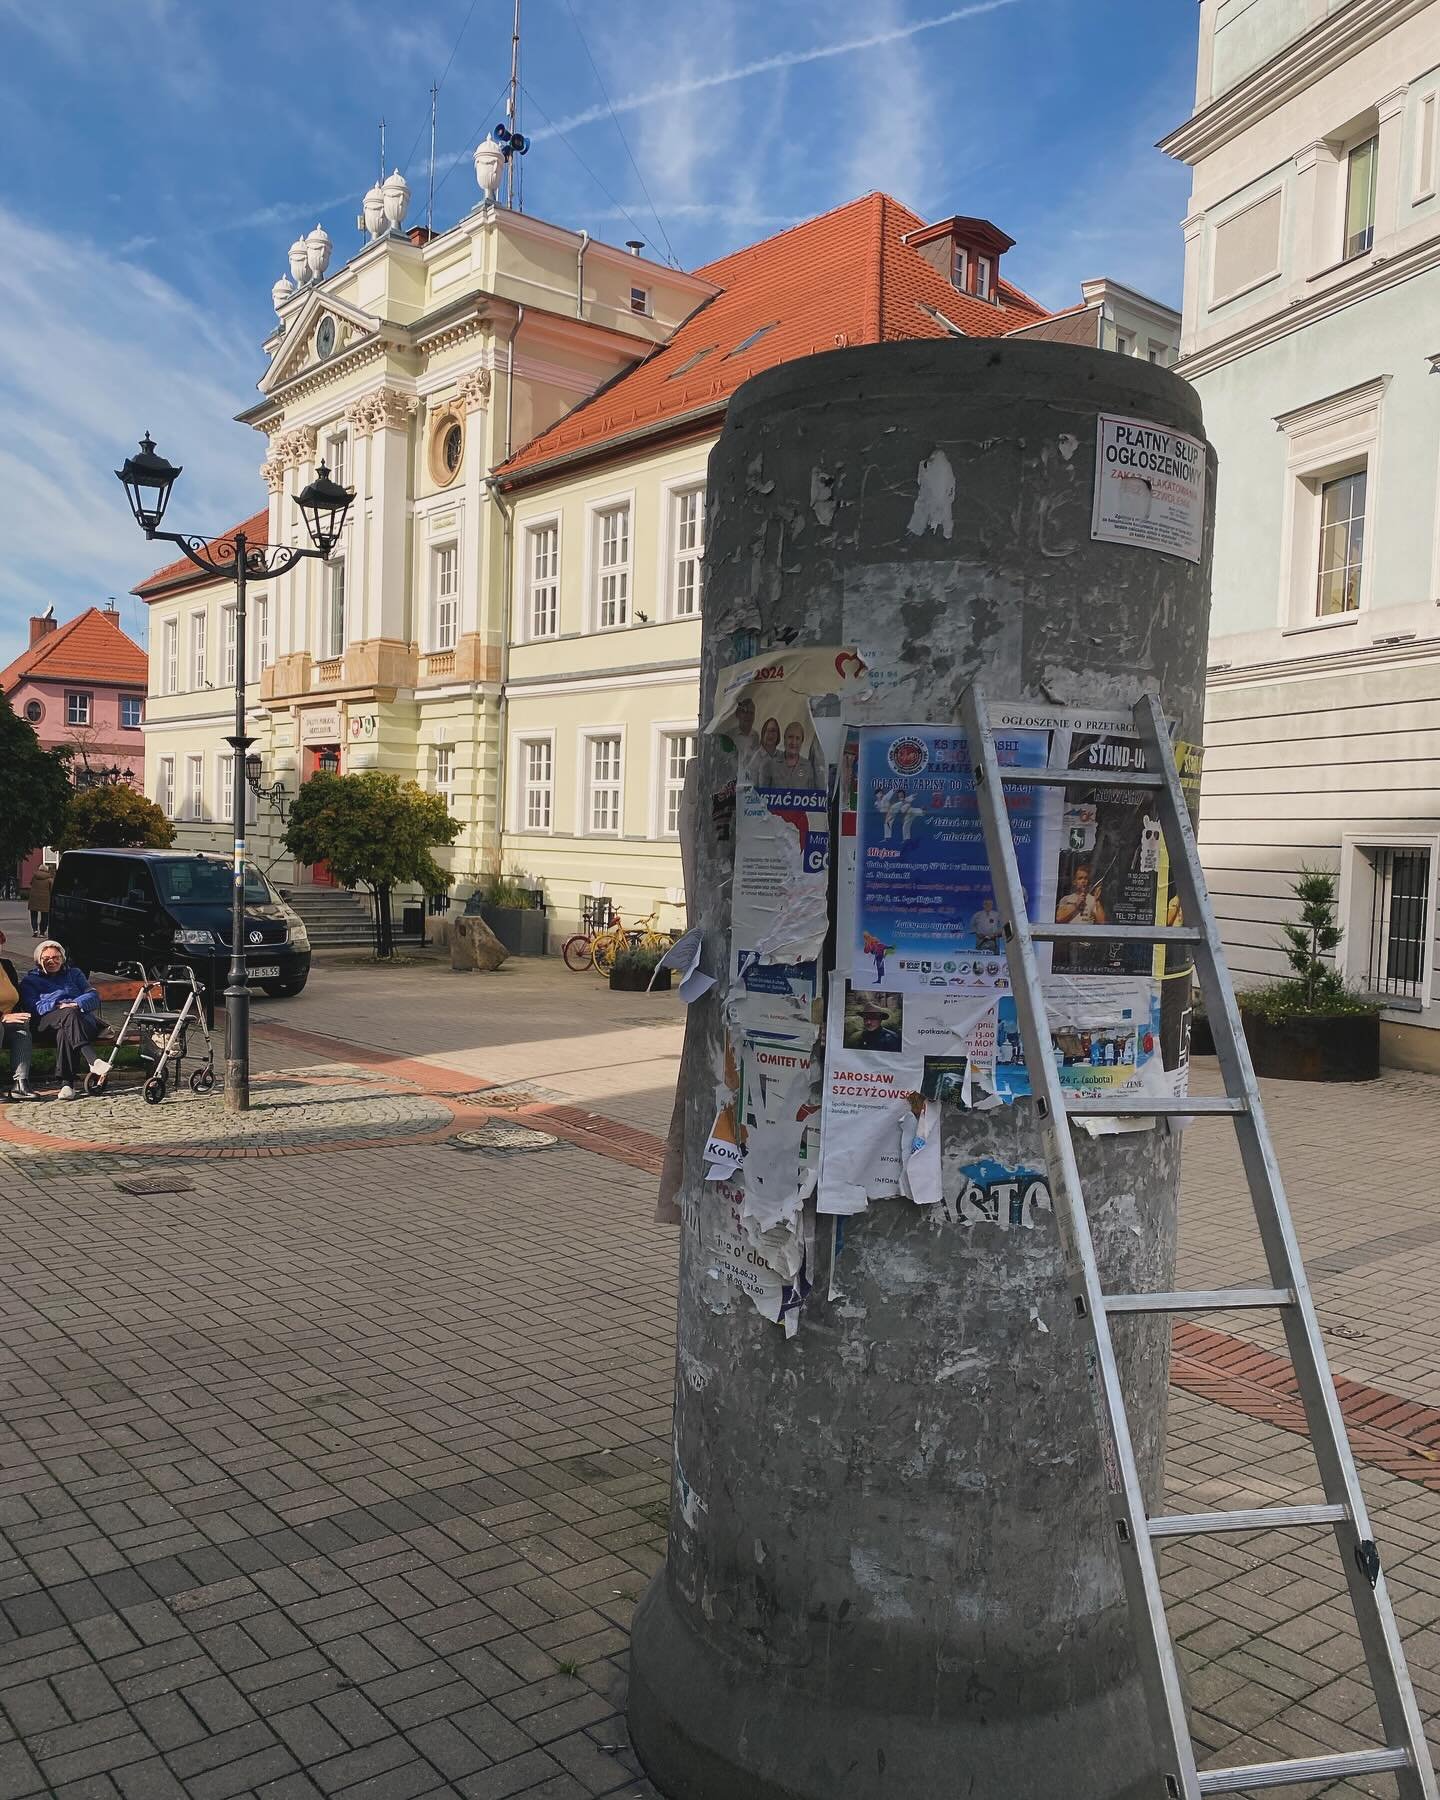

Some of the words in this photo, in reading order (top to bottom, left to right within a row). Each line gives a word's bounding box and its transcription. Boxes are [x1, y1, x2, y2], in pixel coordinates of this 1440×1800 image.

[1116, 426, 1170, 453] PŁATNY
[1175, 441, 1199, 464] SŁUP
[1106, 445, 1202, 486] OGŁOSZENIOWY
[754, 665, 784, 681] 2024
[1001, 715, 1070, 729] OGŁOSZENIE
[1074, 720, 1082, 729] O
[833, 1071, 894, 1084] JAROSŁAW
[1081, 1074, 1113, 1085] (sobota)
[747, 1282, 764, 1295] 21.00
